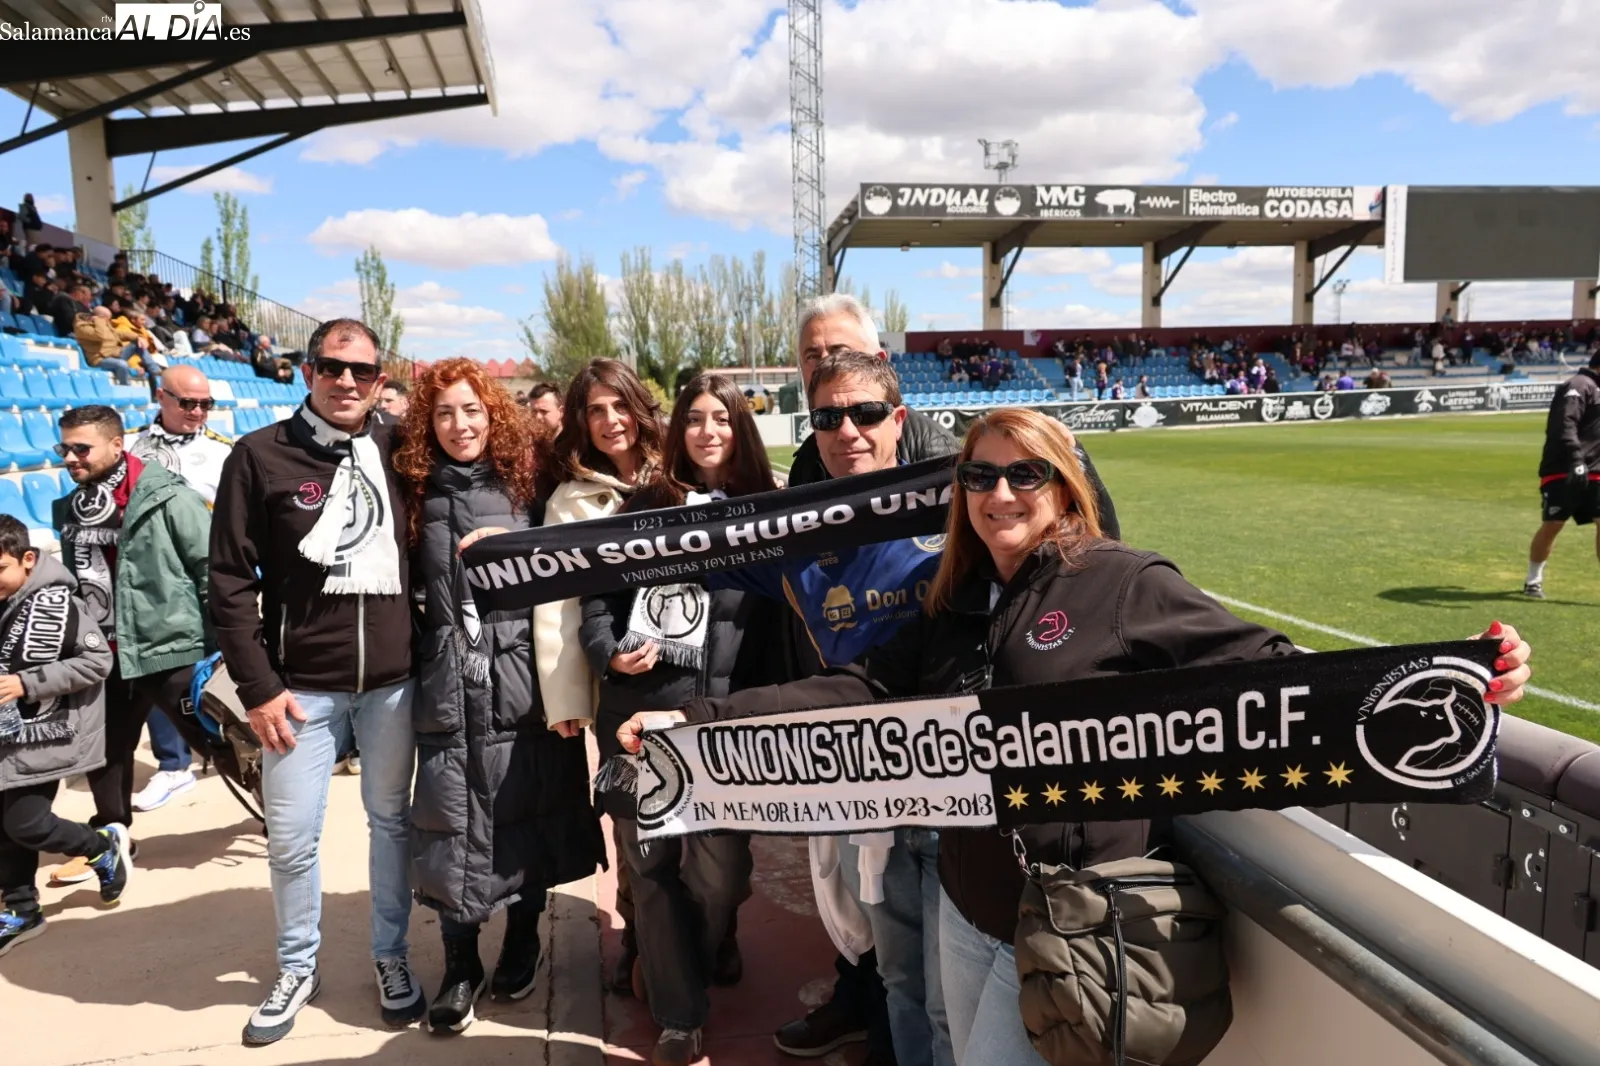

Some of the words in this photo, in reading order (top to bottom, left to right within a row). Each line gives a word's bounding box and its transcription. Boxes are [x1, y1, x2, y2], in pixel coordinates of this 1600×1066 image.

[1035, 186, 1086, 207] MMG
[1189, 188, 1237, 202] Electro
[1266, 187, 1353, 198] AUTOESCUELA
[1264, 200, 1353, 218] CODASA
[1180, 400, 1257, 412] VITALDENT
[1196, 412, 1240, 422] SALAMANCA
[633, 516, 663, 531] 1923
[680, 510, 708, 525] VDS
[724, 503, 756, 517] 2013
[466, 547, 589, 592] UNIÓN
[597, 528, 712, 565] SOLO
[725, 503, 855, 547] HUBO
[750, 546, 785, 562] FANS
[866, 587, 907, 611] Don
[698, 717, 912, 786] UNIONISTAS
[964, 706, 1224, 774] Salamanca
[1236, 685, 1322, 751] C.F.
[840, 797, 880, 821] VDS
